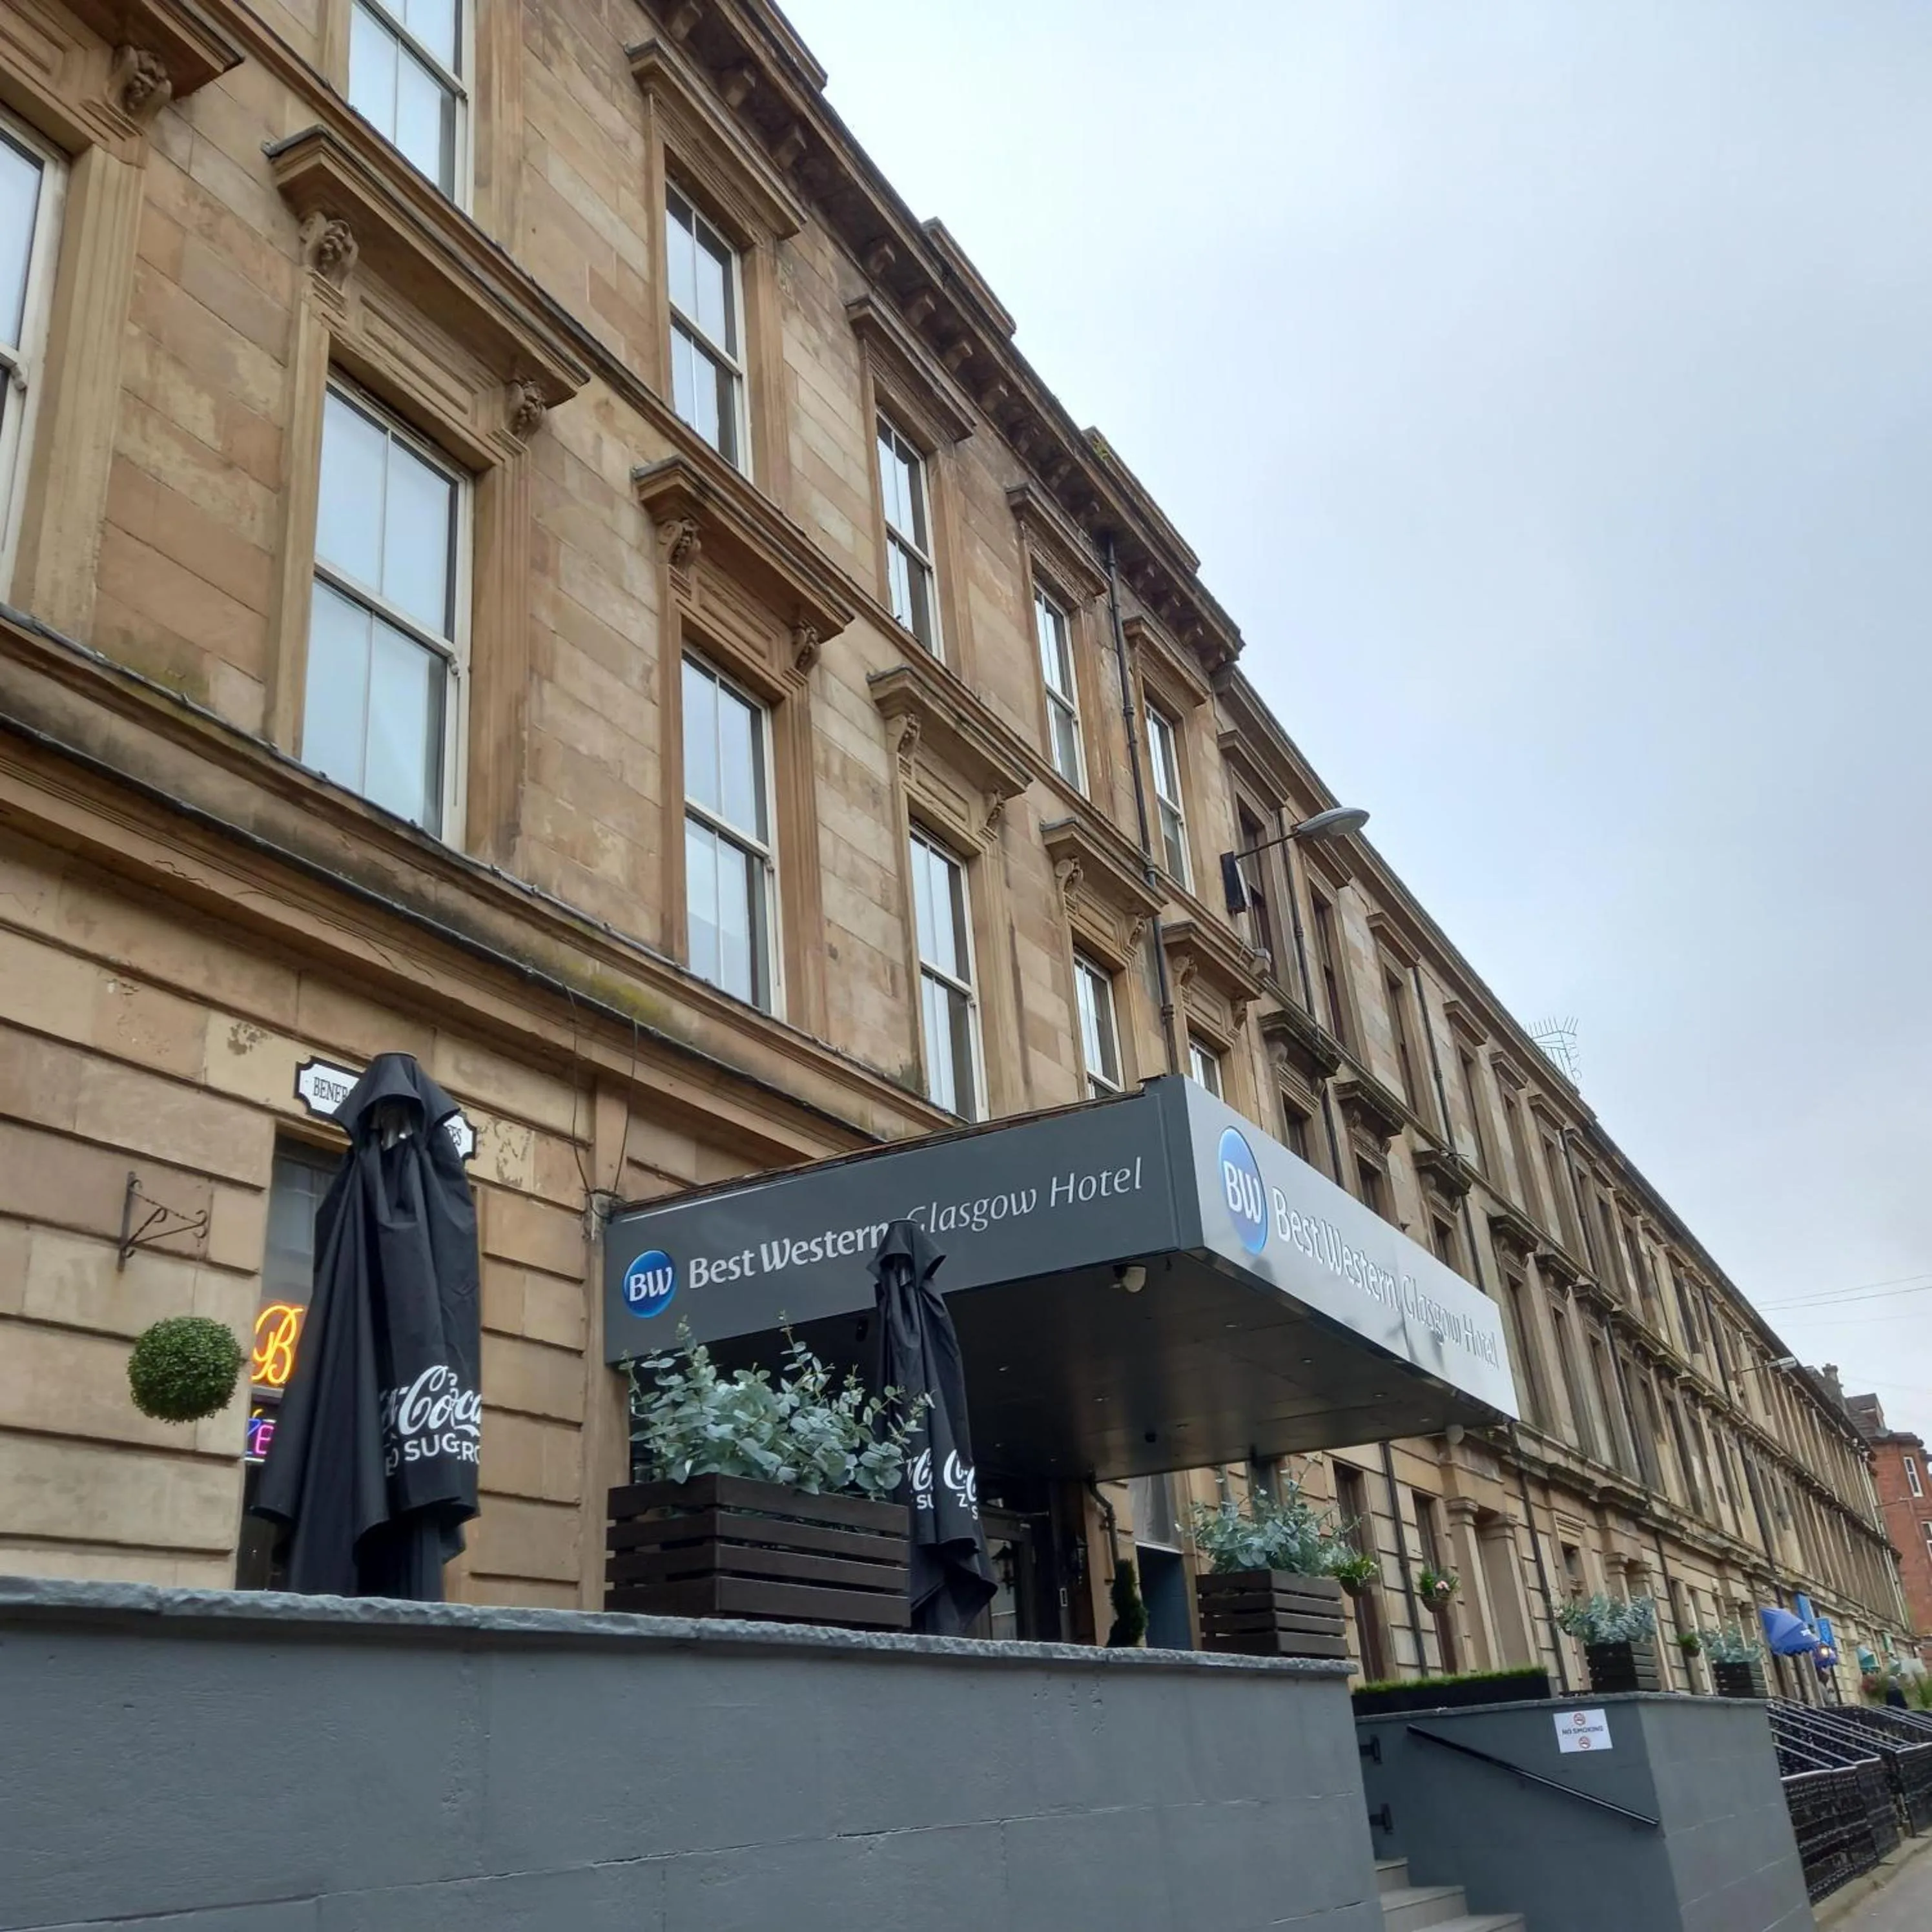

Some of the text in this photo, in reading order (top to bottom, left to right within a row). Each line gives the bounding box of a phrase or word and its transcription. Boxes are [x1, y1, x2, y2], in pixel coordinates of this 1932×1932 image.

[629, 1266, 673, 1302] BW
[689, 1249, 756, 1289] Best
[759, 1222, 889, 1273] Western
[1050, 1156, 1142, 1208] Hotel
[1223, 1160, 1499, 1370] BW Best Western Glasgow Hotel
